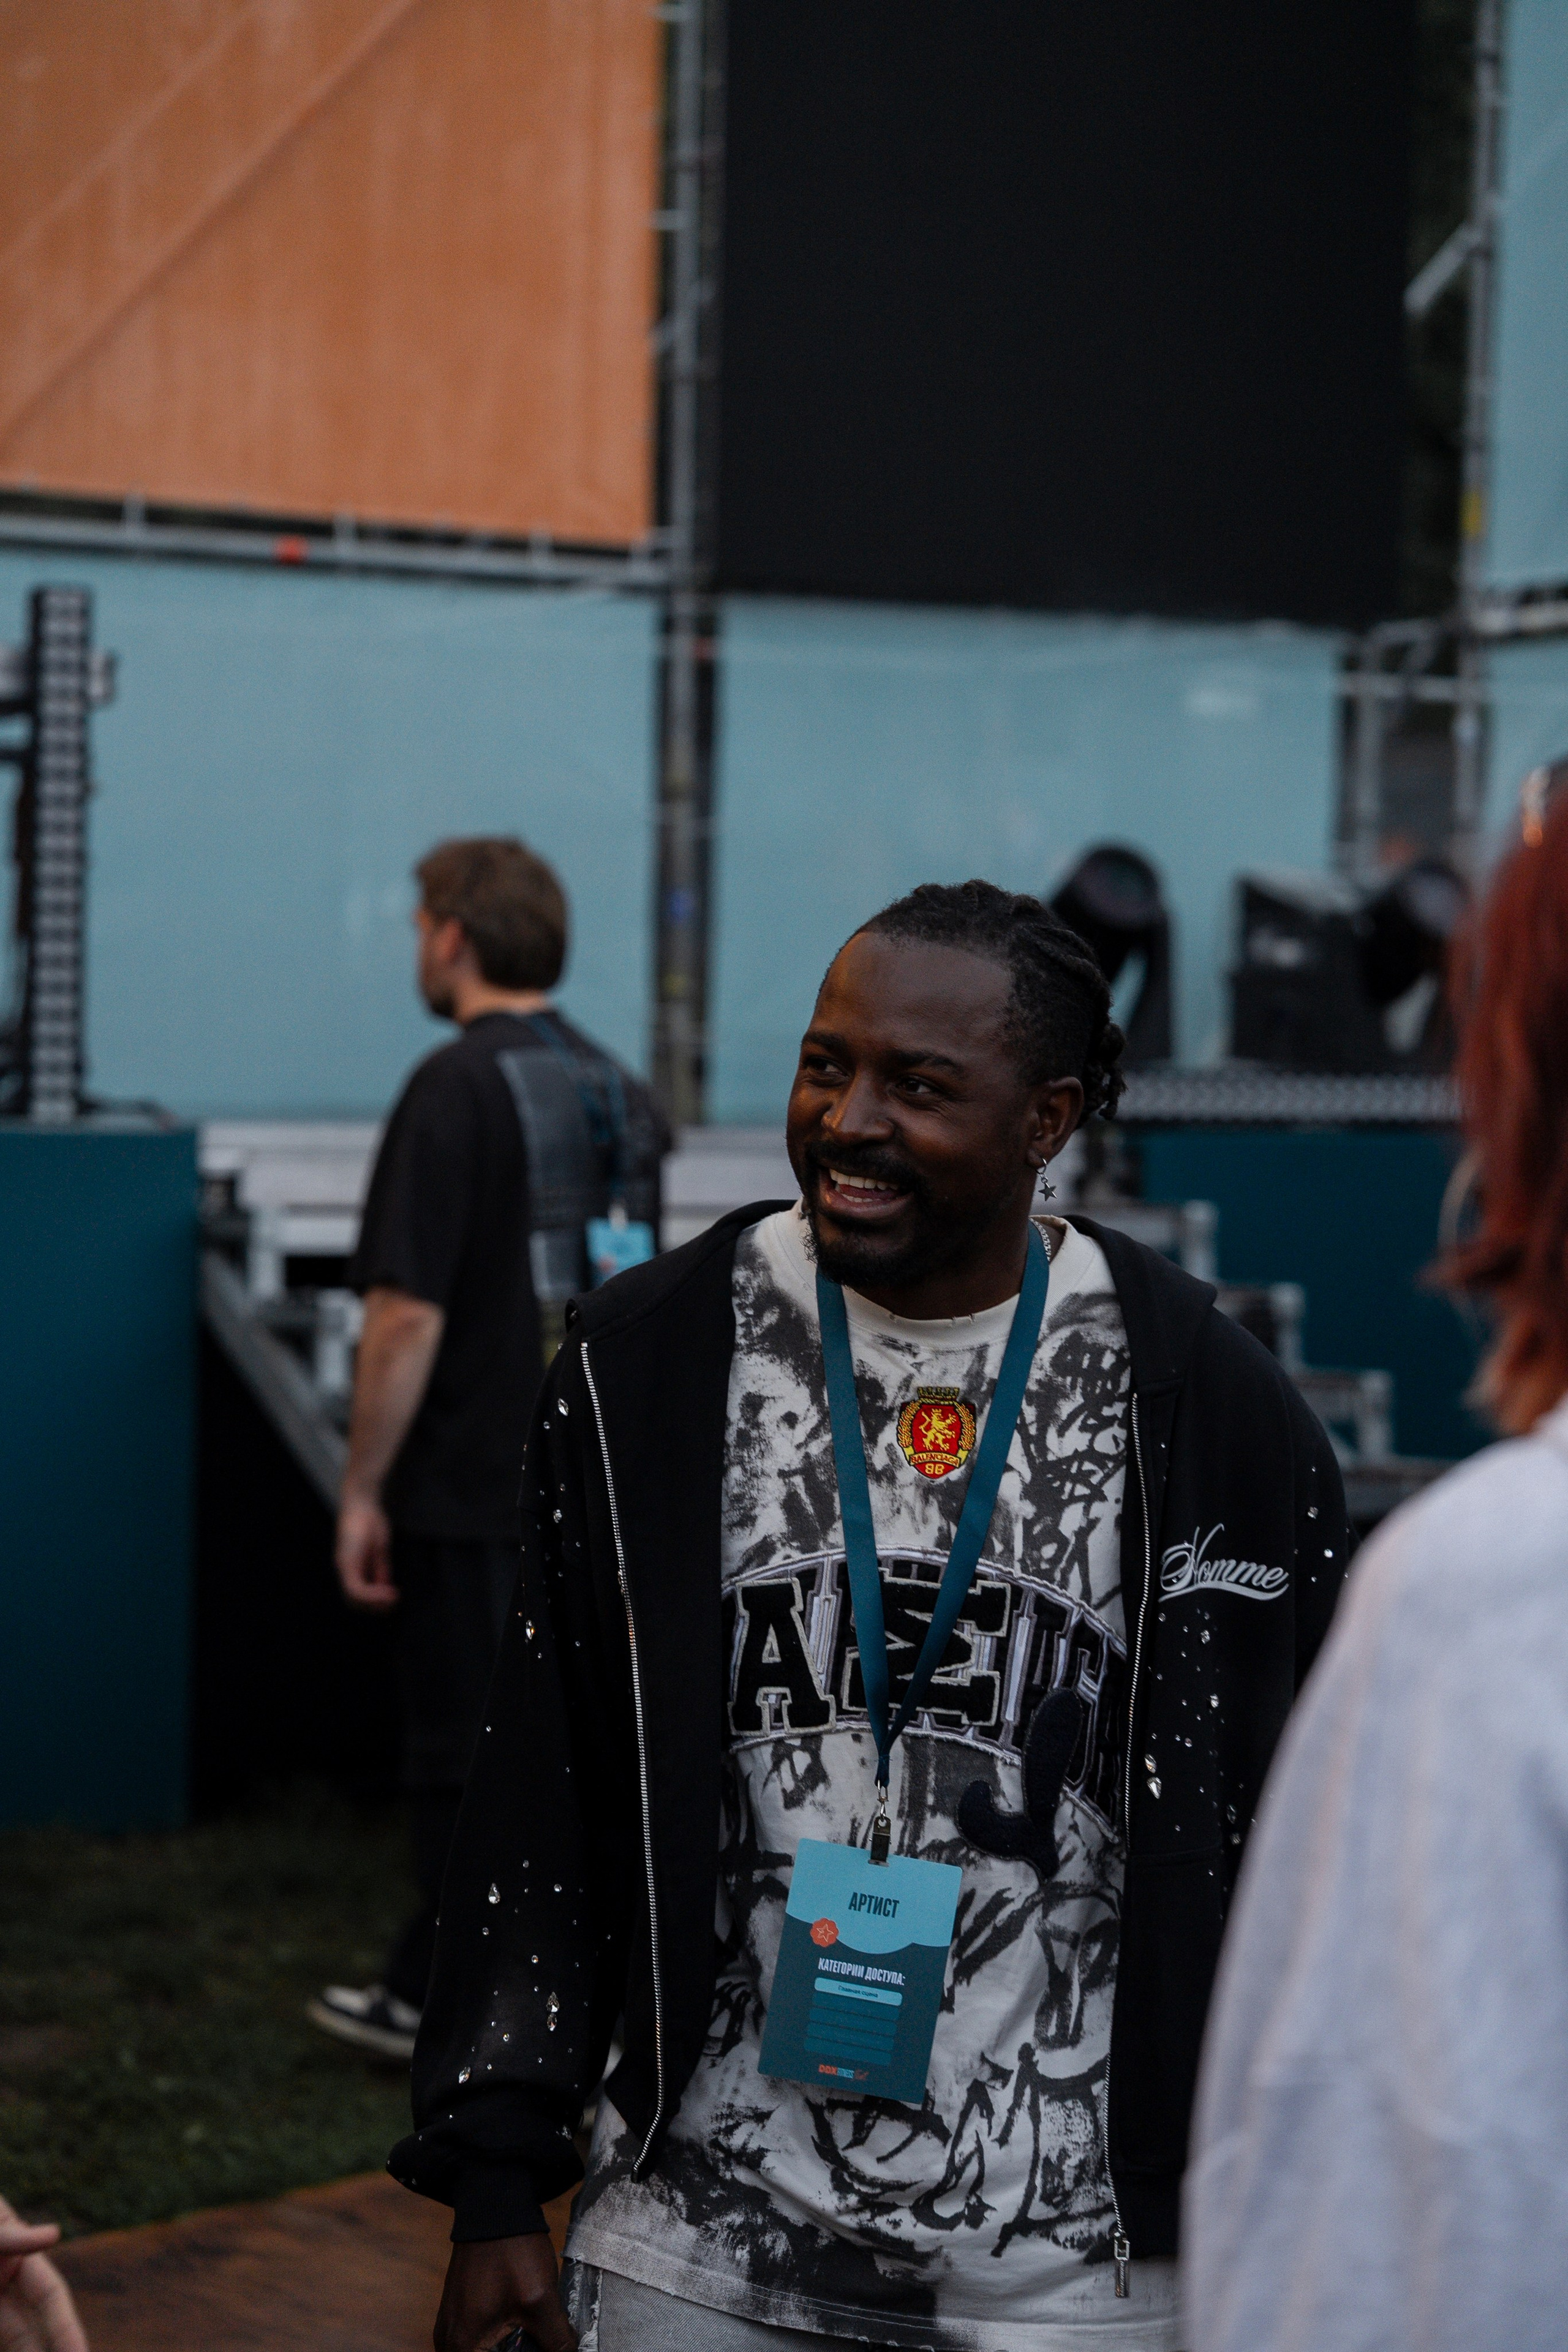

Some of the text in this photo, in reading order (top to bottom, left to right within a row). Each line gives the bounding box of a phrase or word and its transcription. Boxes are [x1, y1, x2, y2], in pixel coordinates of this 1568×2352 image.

[848, 1891, 900, 1918] АРТИСТ
[818, 1957, 906, 1986] КАТЕГОРИИ ДОСТУПА:
